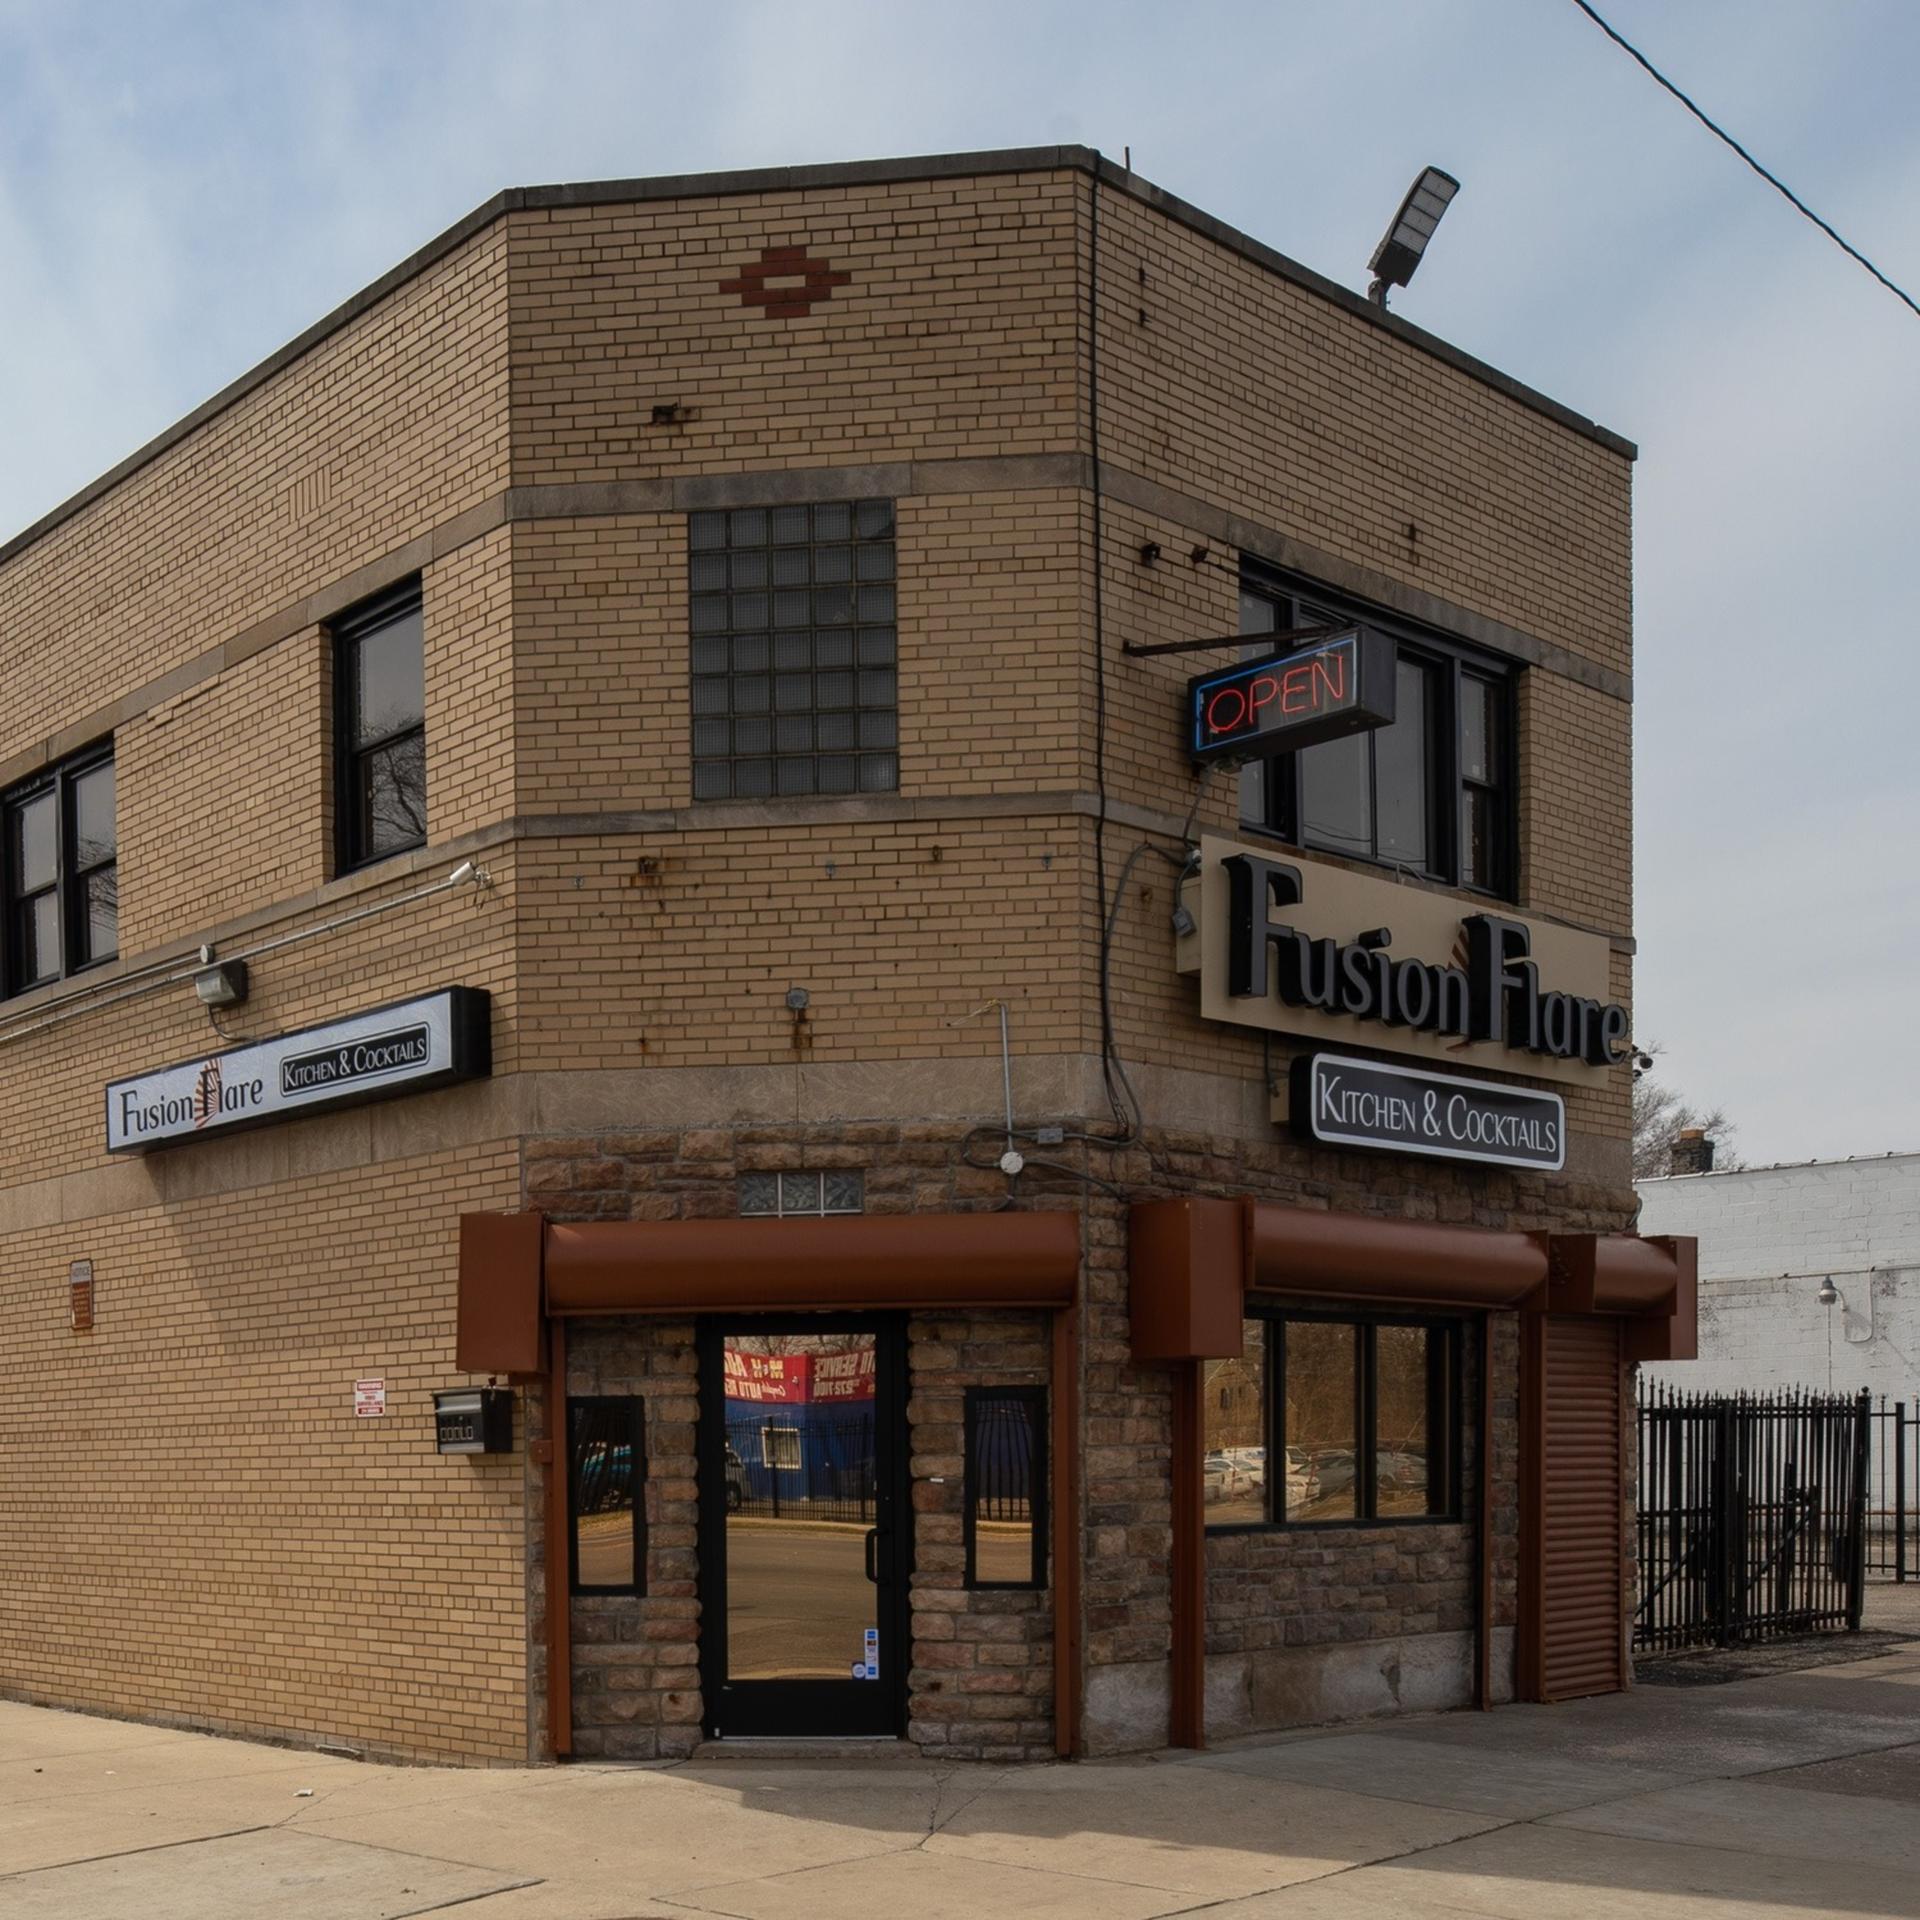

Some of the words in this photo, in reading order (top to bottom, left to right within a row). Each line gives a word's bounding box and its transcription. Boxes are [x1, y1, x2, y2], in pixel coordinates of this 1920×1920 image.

[1208, 654, 1343, 731] OPEN
[284, 1063, 336, 1089] KITCHEN
[339, 1055, 352, 1076] &
[353, 1037, 425, 1071] COCKTAILS
[1319, 1073, 1416, 1132] KITCHEN
[1422, 1089, 1441, 1137] &
[1447, 1094, 1557, 1153] COCKTAILS
